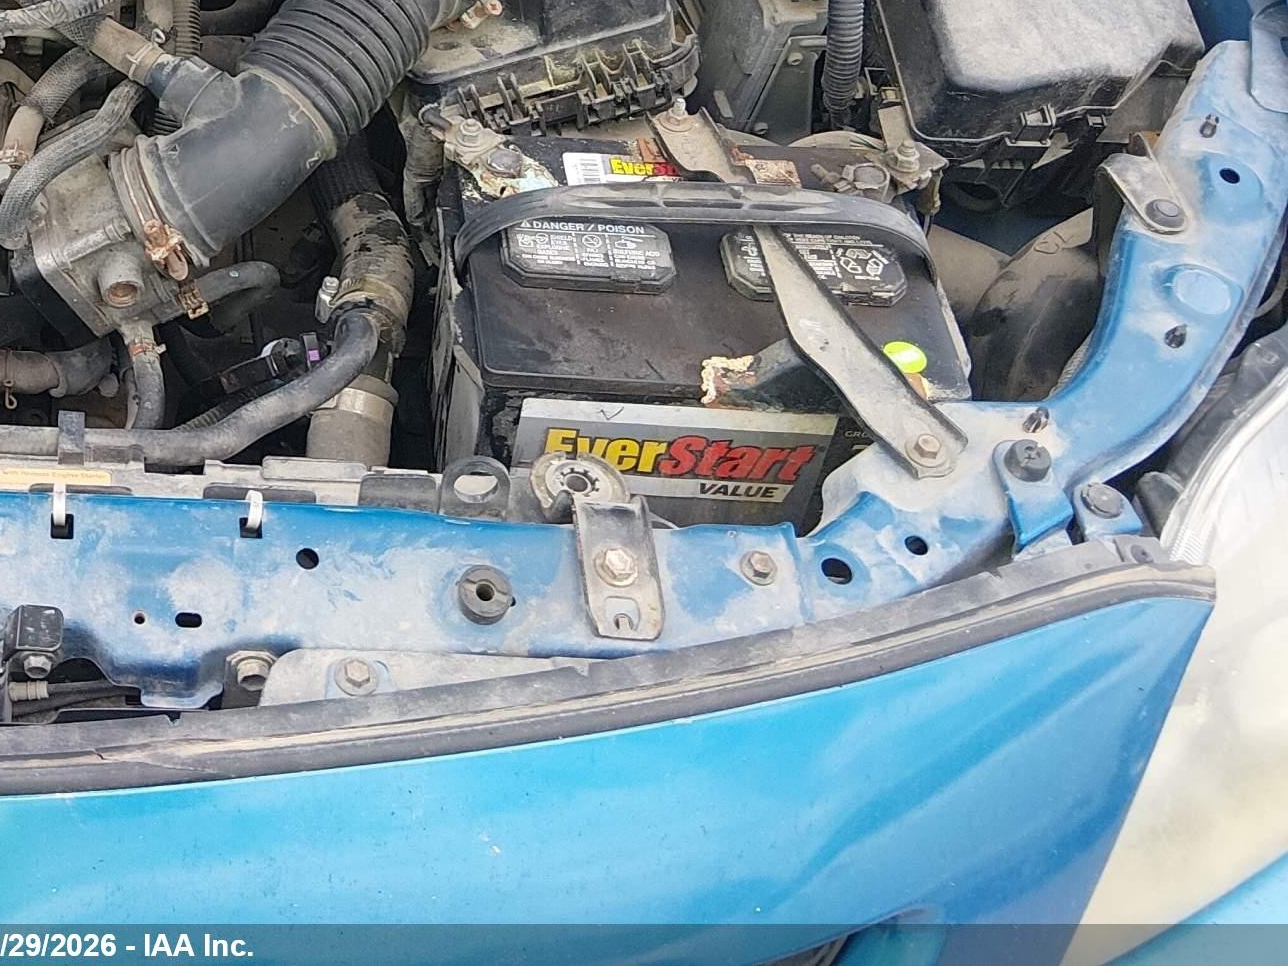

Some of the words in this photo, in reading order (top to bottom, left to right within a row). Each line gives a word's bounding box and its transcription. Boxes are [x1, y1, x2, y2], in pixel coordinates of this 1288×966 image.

[532, 220, 585, 231] DANGER
[597, 224, 645, 234] POISON
[543, 426, 817, 483] EverStart
[698, 482, 777, 499] VALUE
